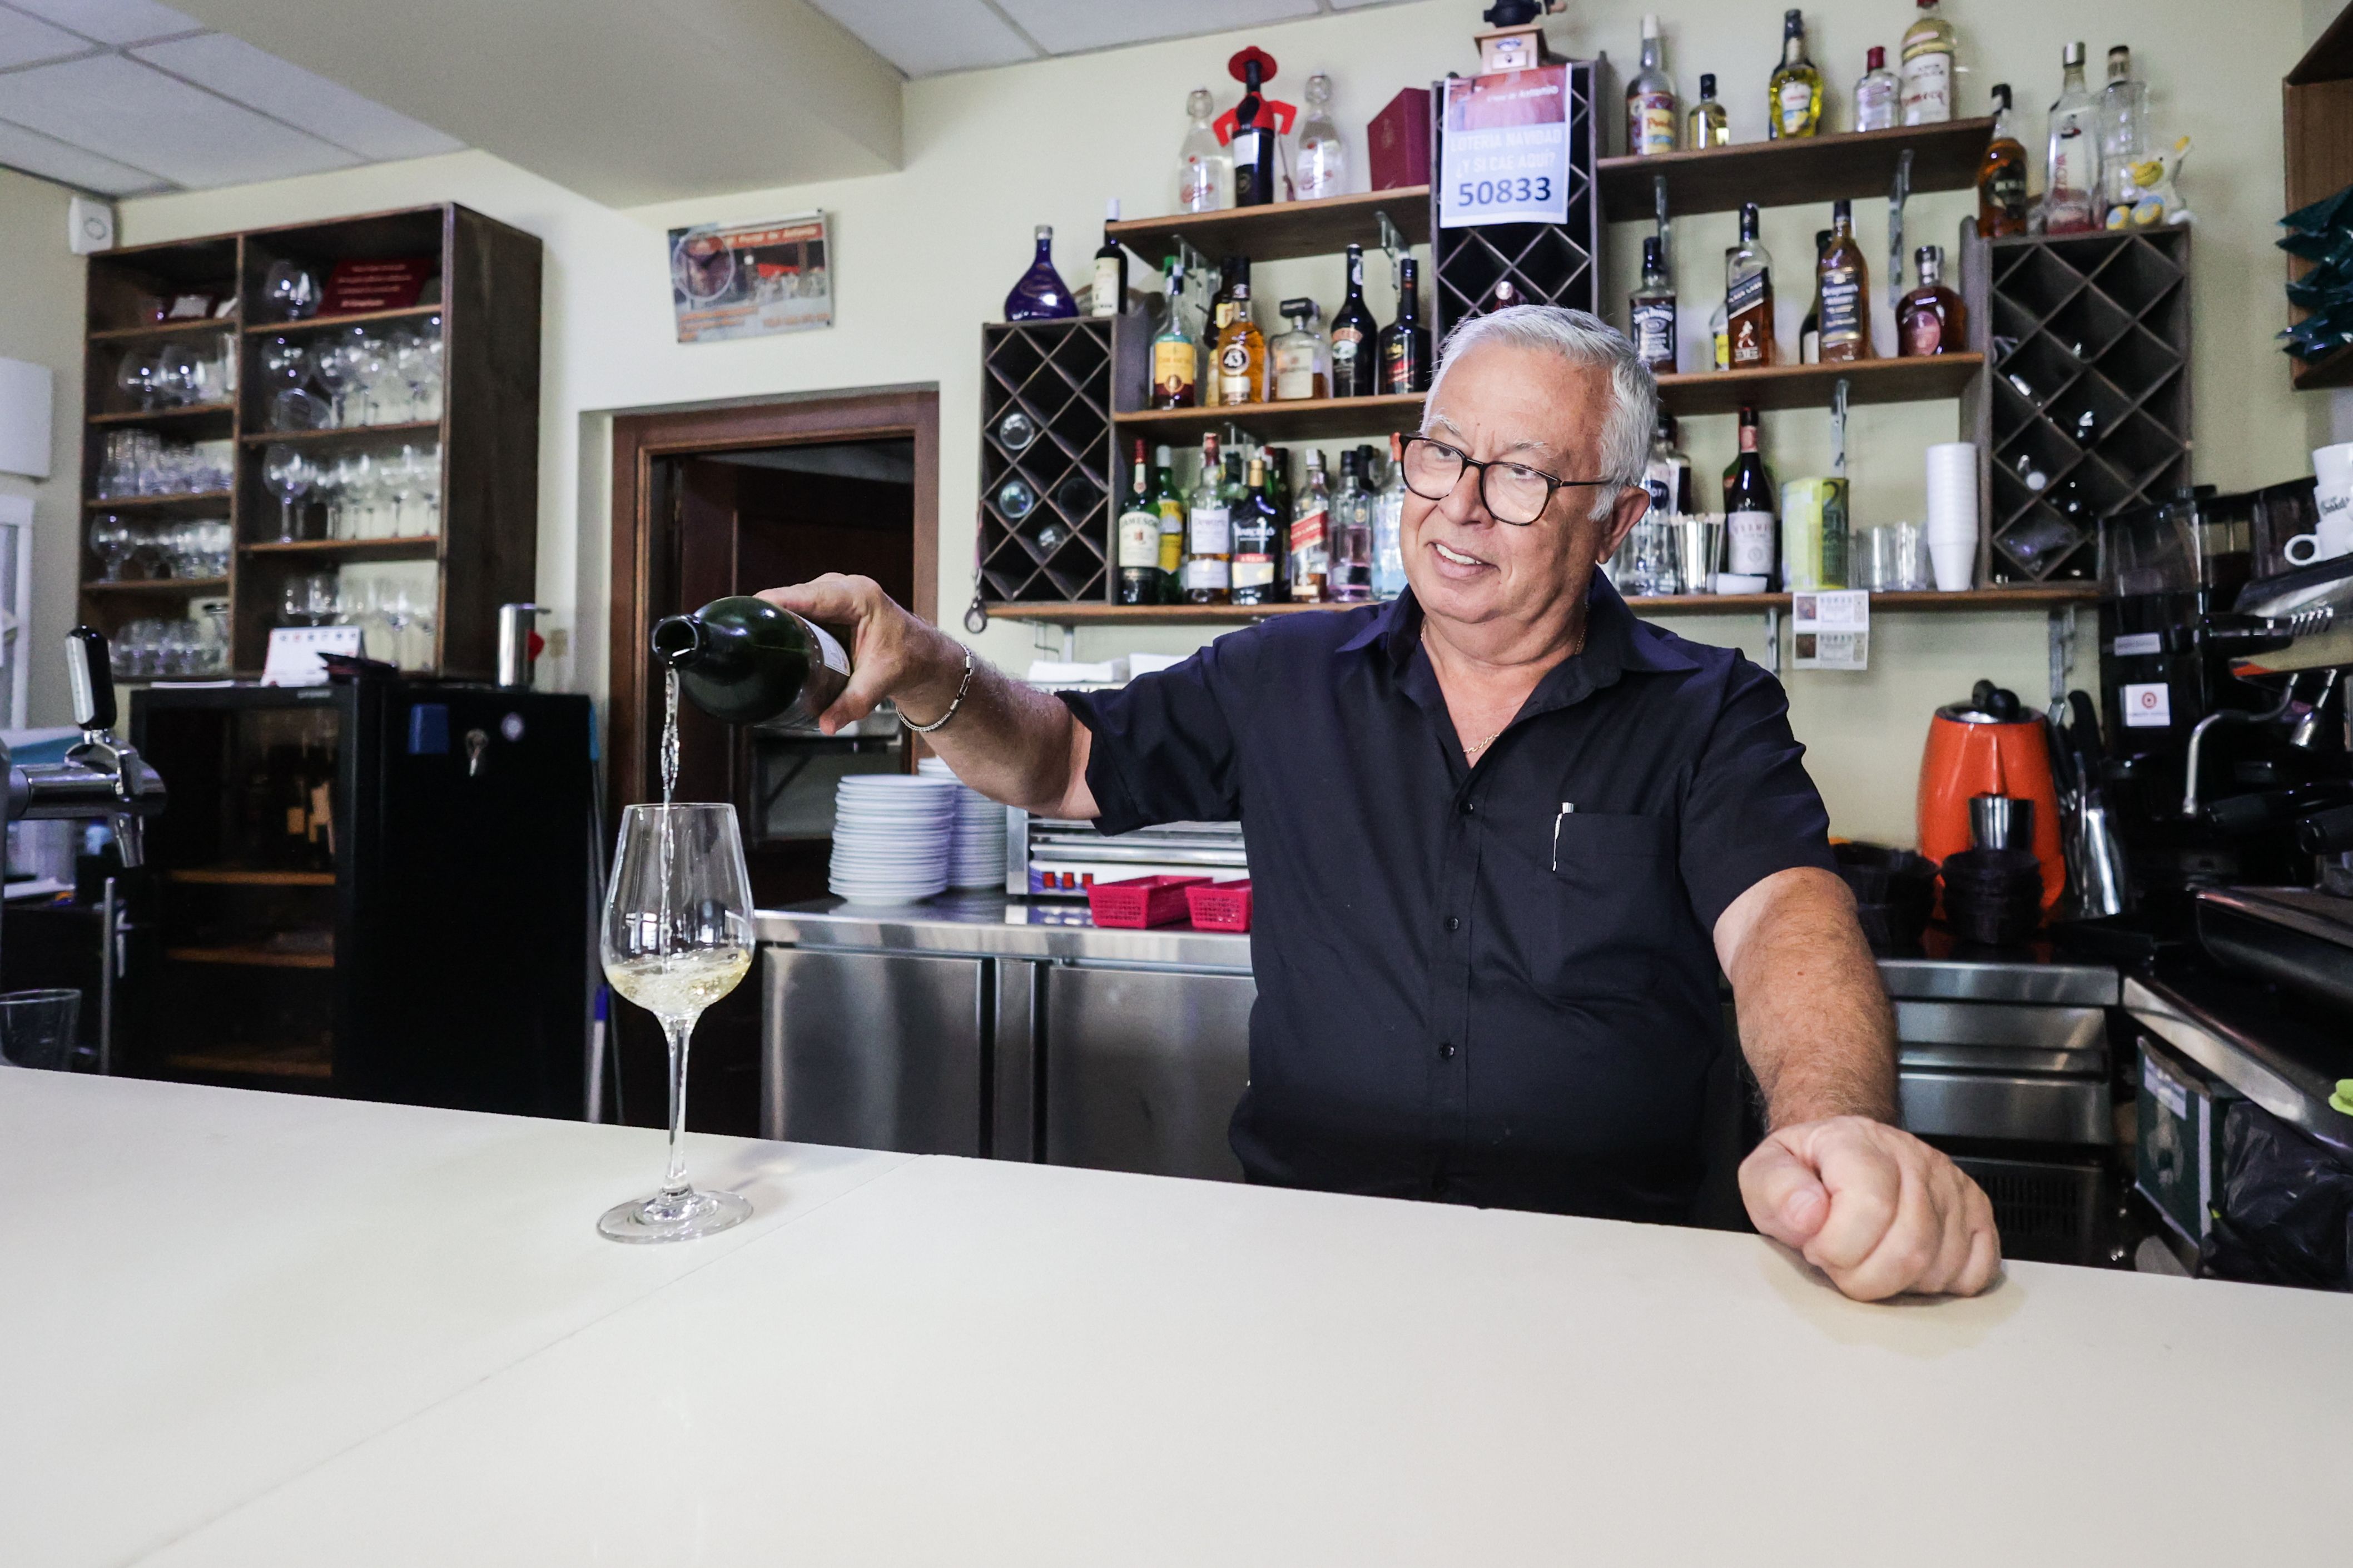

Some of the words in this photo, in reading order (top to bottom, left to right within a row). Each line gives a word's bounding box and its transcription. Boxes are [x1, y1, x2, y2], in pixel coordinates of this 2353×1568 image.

[1506, 128, 1563, 147] NAVIDAD
[1458, 177, 1551, 207] 50833
[1224, 350, 1243, 367] 43
